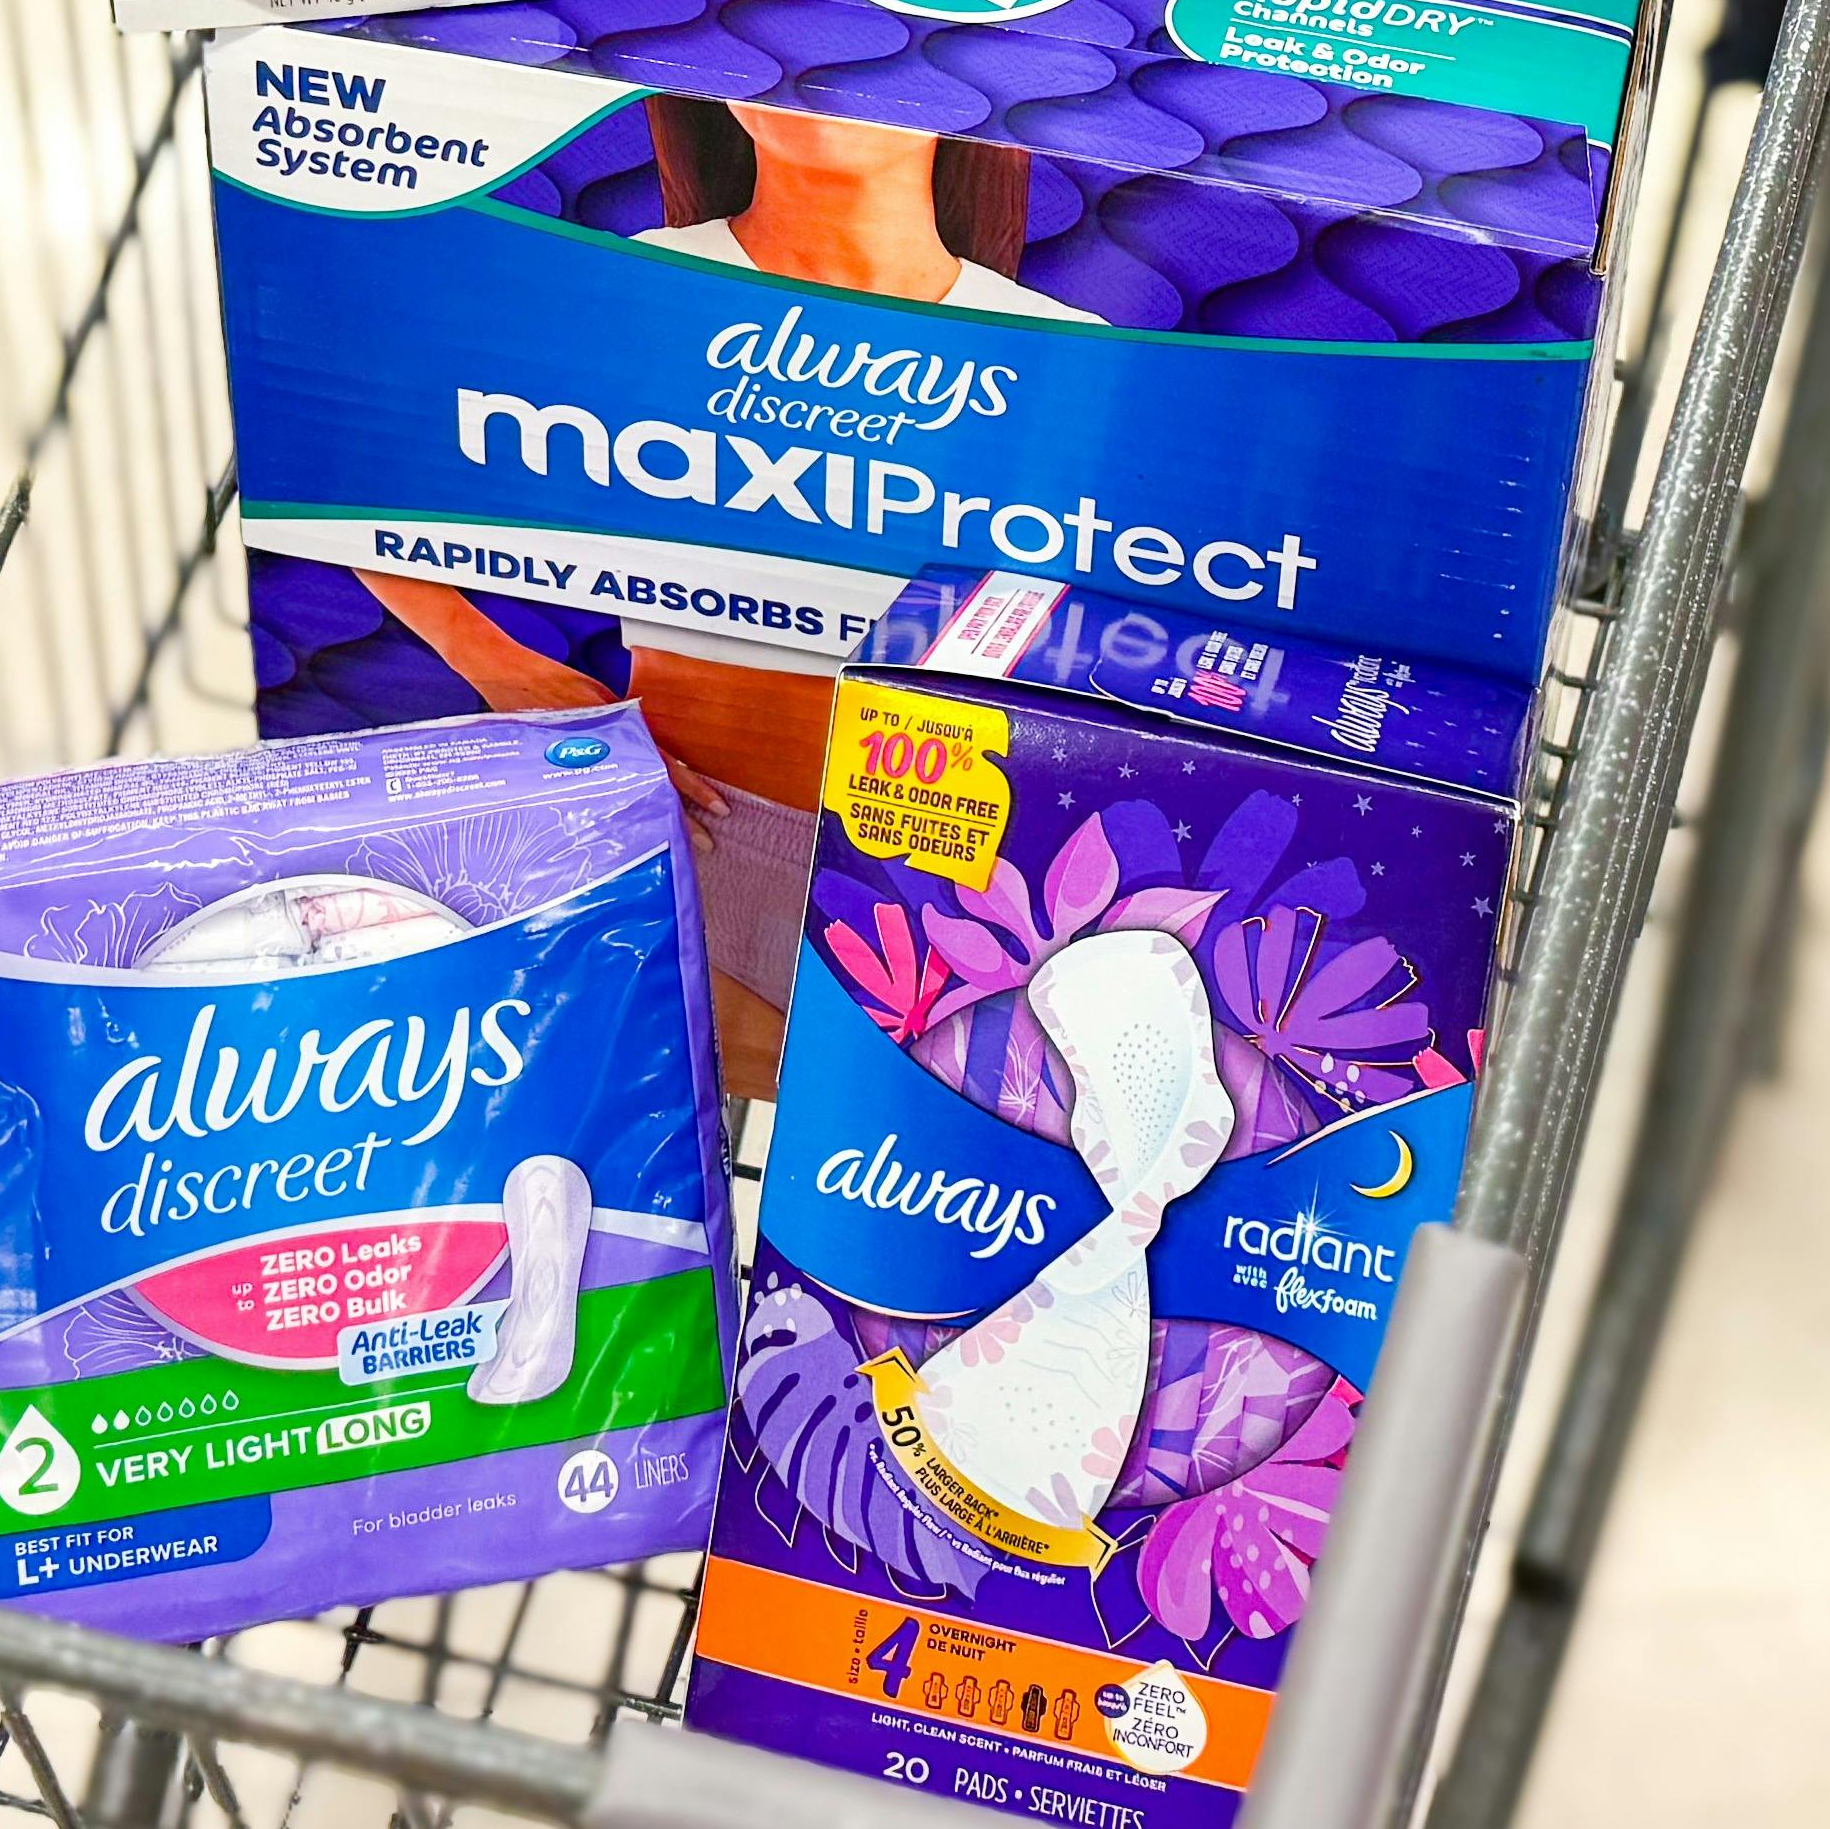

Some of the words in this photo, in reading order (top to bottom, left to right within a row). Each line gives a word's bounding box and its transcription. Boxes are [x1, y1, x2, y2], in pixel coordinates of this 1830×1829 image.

[1233, 0, 1373, 38] Channels
[1219, 43, 1393, 90] Protection
[1225, 26, 1305, 57] Leak
[1312, 43, 1335, 61] &
[1342, 47, 1426, 76] Odor
[254, 60, 387, 114] NEW
[251, 105, 490, 169] Absorbent
[254, 137, 418, 191] System
[705, 305, 1019, 430] always
[706, 376, 924, 446] discreet
[374, 528, 578, 591] RAPIDLY
[590, 570, 824, 637] ABSORBS
[860, 707, 878, 722] UP
[883, 712, 899, 727] TO
[559, 743, 603, 759] P&G
[859, 730, 973, 785] 100%
[849, 774, 891, 798] LEAK
[909, 787, 952, 811] ODOR
[956, 796, 999, 820] FREE
[850, 803, 895, 826] SANS
[901, 814, 962, 841] FUITES
[967, 830, 989, 846] ET
[858, 823, 902, 846] SANS
[909, 834, 976, 862] ODEURS
[83, 997, 533, 1152] always
[100, 1131, 393, 1238] discreet
[816, 1133, 1058, 1260] always
[260, 1246, 335, 1276] ZERO
[341, 1234, 422, 1264] Leaks
[1223, 1211, 1396, 1283] radiant
[262, 1273, 338, 1304] ZERO
[344, 1263, 412, 1291] Odor
[1274, 1266, 1378, 1320] flexfoam
[266, 1301, 340, 1331] ZERO
[347, 1289, 407, 1319] Bulk
[351, 1310, 483, 1356] Anti-Leak
[362, 1338, 475, 1375] BARRIERS
[14, 1436, 60, 1497] 2
[96, 1445, 193, 1489] VERY
[206, 1425, 312, 1470] LIGHT
[323, 1408, 425, 1450] LONG
[564, 1459, 615, 1504] 44
[633, 1452, 691, 1490] LINERS
[14, 1536, 60, 1557] BEST
[65, 1531, 93, 1548] FIT
[96, 1526, 134, 1543] FOR
[18, 1554, 60, 1587] L+
[69, 1535, 219, 1575] UNDERWEAR
[865, 1616, 921, 1699] 4
[927, 1638, 948, 1653] DE
[950, 1641, 986, 1662] NUIT
[929, 1623, 1017, 1654] OVERNIGHT
[1138, 1681, 1185, 1704] ZERO
[872, 1712, 910, 1732] LIGHT,
[913, 1723, 957, 1742] CLEAN
[959, 1732, 1002, 1753] SCENT
[1012, 1747, 1064, 1768] PARFUM
[1113, 1728, 1194, 1758] INCONFORT
[1132, 1717, 1179, 1739] ZÉRO
[882, 1750, 930, 1784] 20
[954, 1767, 1009, 1803] PADS
[1028, 1786, 1145, 1829] SERVIETTES
